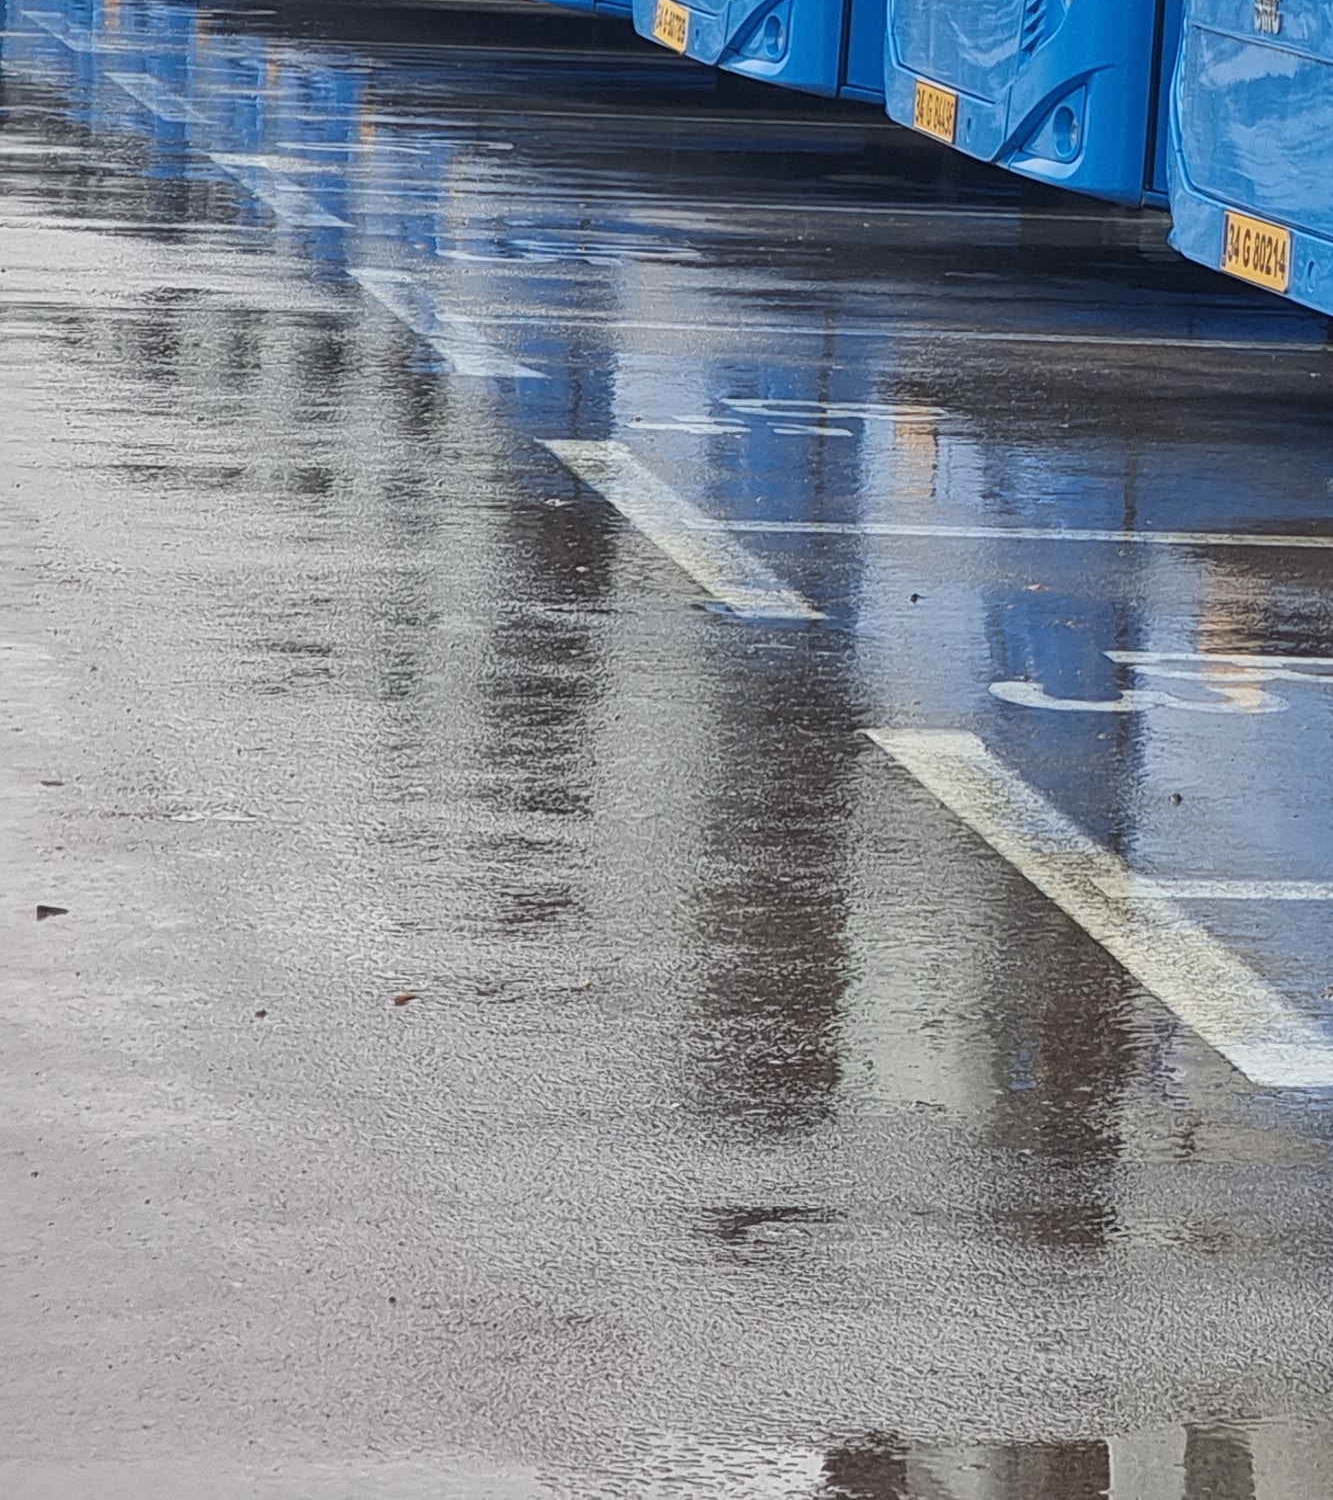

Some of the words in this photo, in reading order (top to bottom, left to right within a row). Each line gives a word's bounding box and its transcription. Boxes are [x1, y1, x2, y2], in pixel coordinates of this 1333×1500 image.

[1228, 223, 1241, 264] 34
[1243, 228, 1251, 268] G
[1253, 231, 1286, 280] 80214
